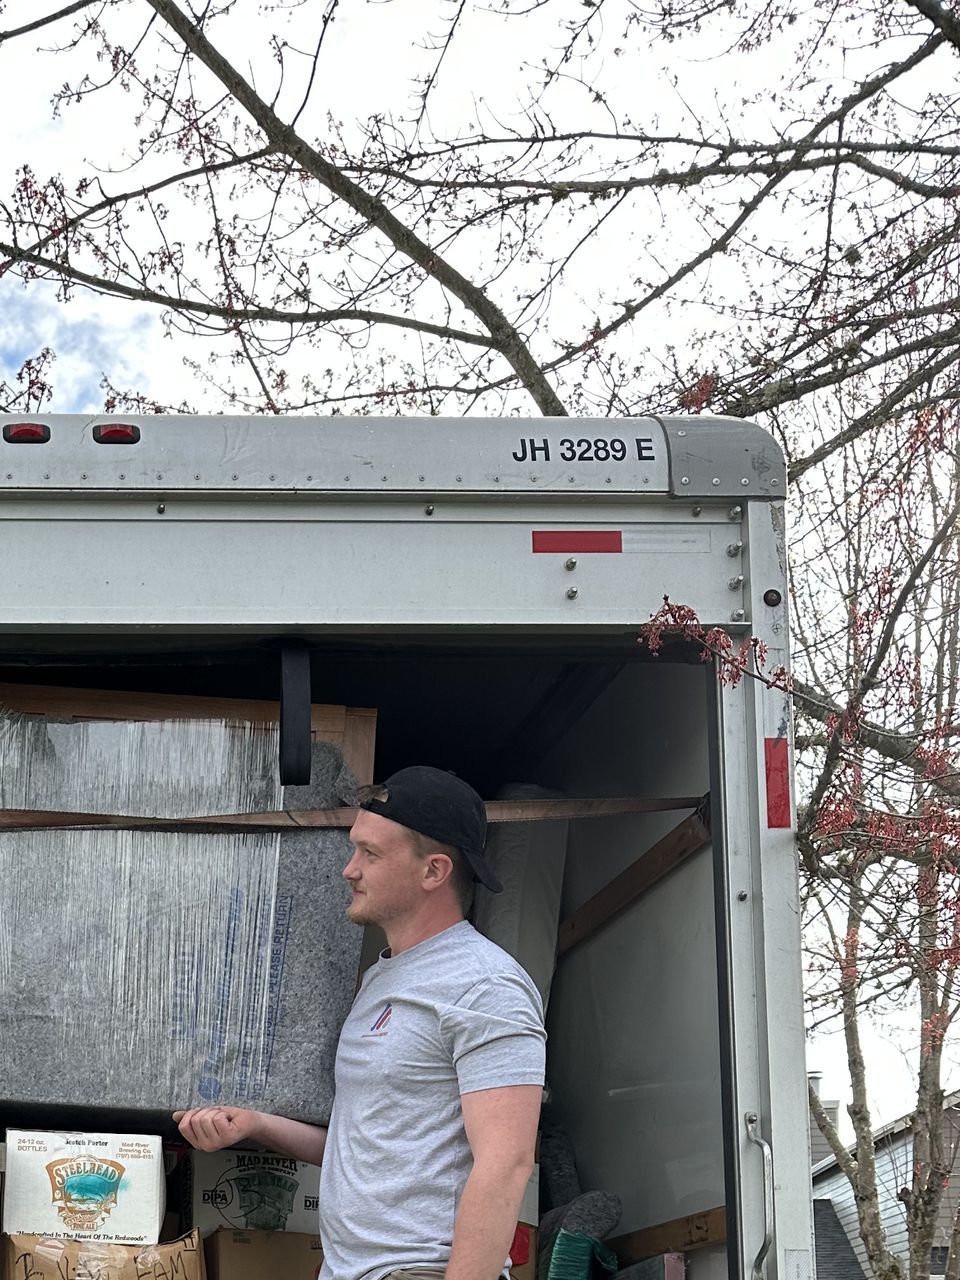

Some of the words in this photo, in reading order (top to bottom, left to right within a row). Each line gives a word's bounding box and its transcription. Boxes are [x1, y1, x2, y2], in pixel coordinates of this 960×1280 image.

[512, 438, 550, 462] JH
[560, 438, 627, 462] 3289
[635, 438, 655, 461] E
[87, 1139, 109, 1148] Porter
[236, 1154, 260, 1168] MAD
[261, 1156, 298, 1172] RIVER
[54, 1162, 118, 1186] STEELHEAD
[93, 1233, 102, 1241] Of
